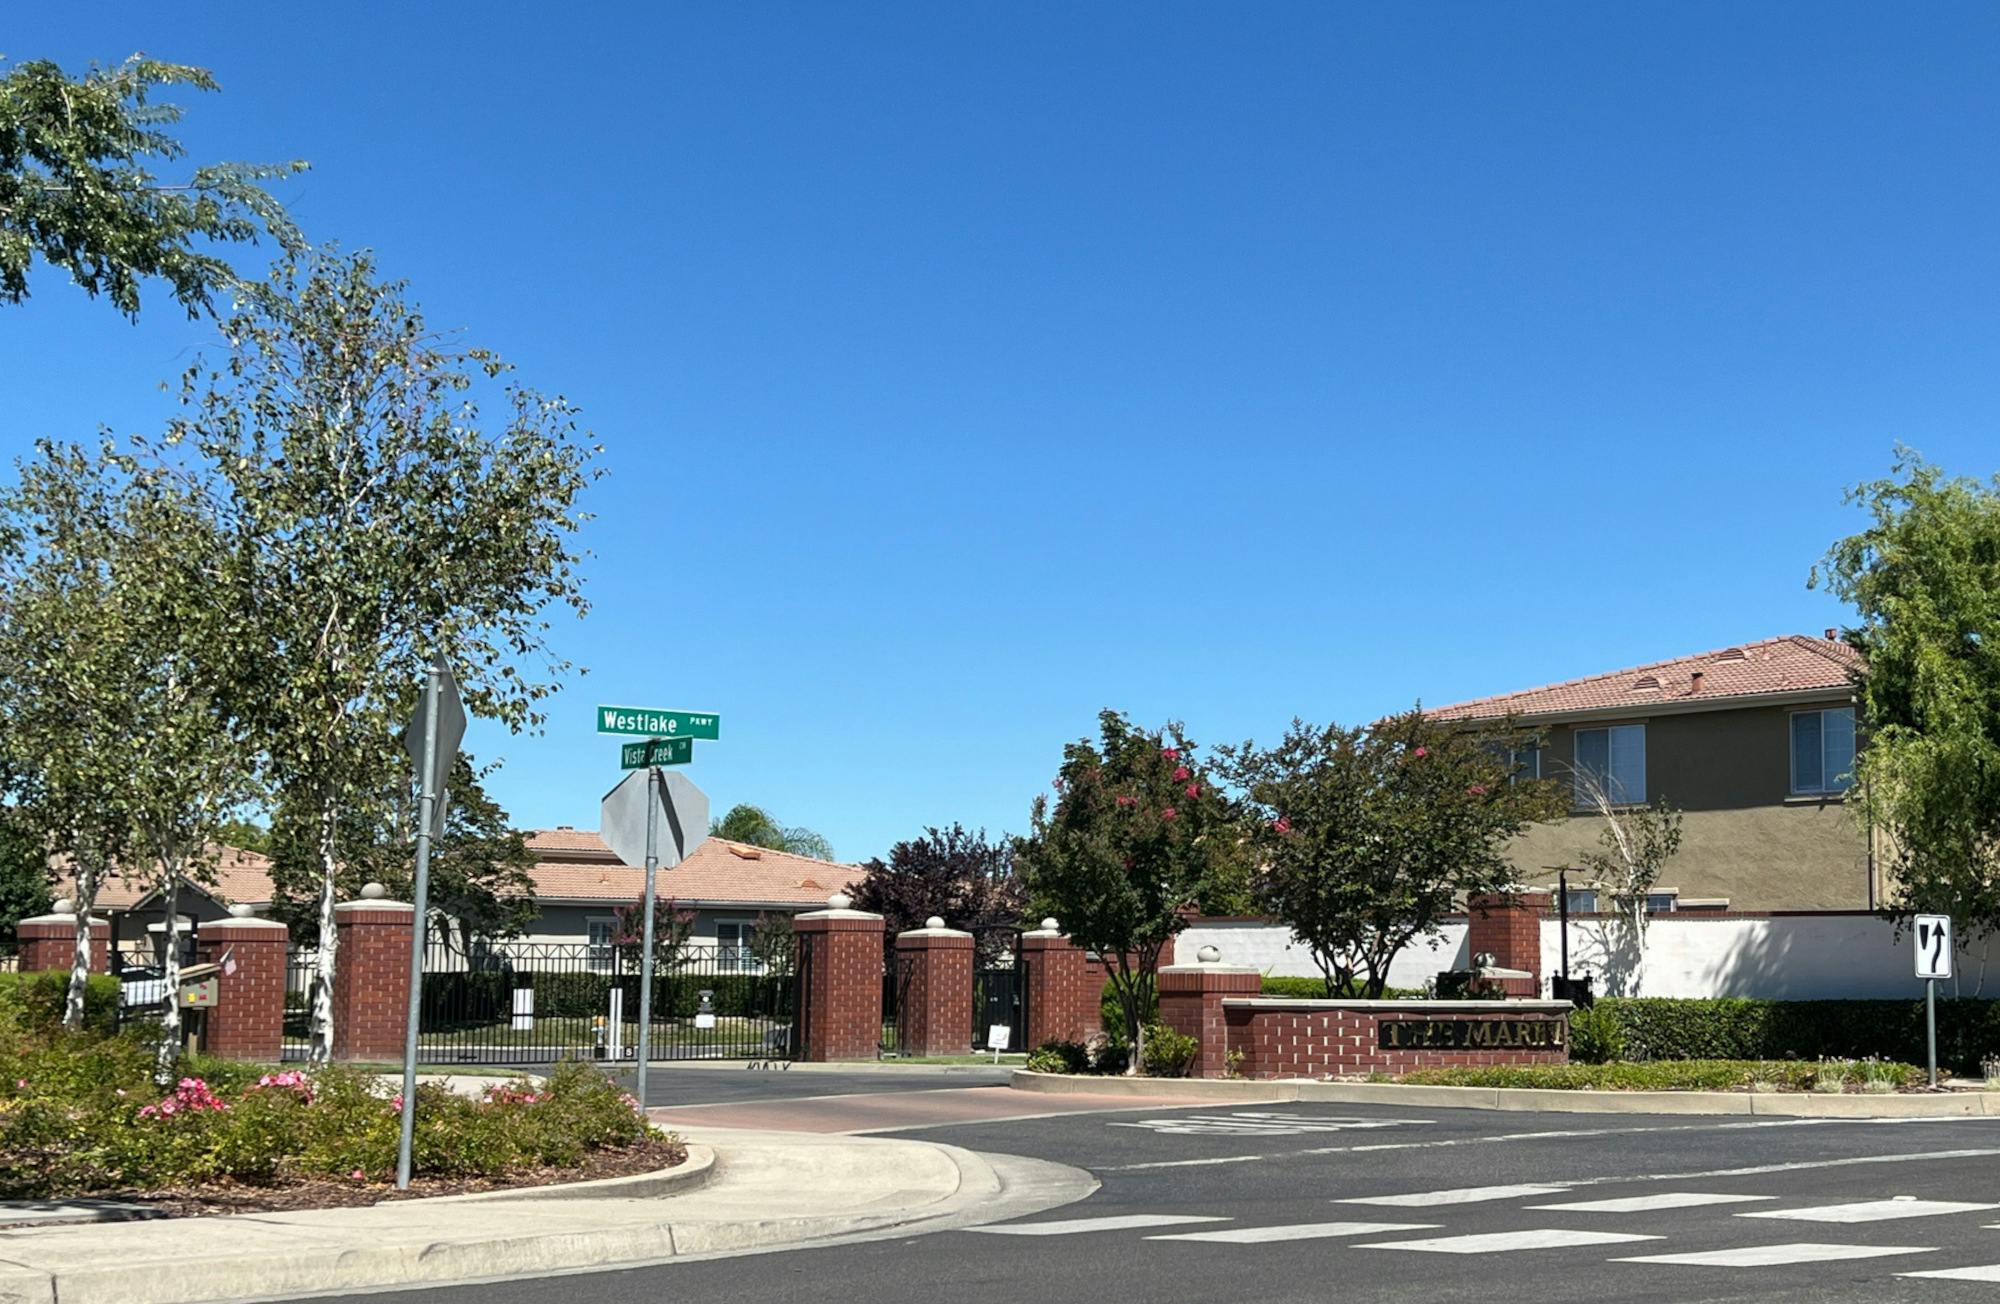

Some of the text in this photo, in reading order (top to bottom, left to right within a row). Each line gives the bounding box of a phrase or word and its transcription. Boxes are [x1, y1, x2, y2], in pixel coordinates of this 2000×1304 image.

[604, 710, 713, 733] Westlake PKWY
[624, 748, 646, 765] Vista
